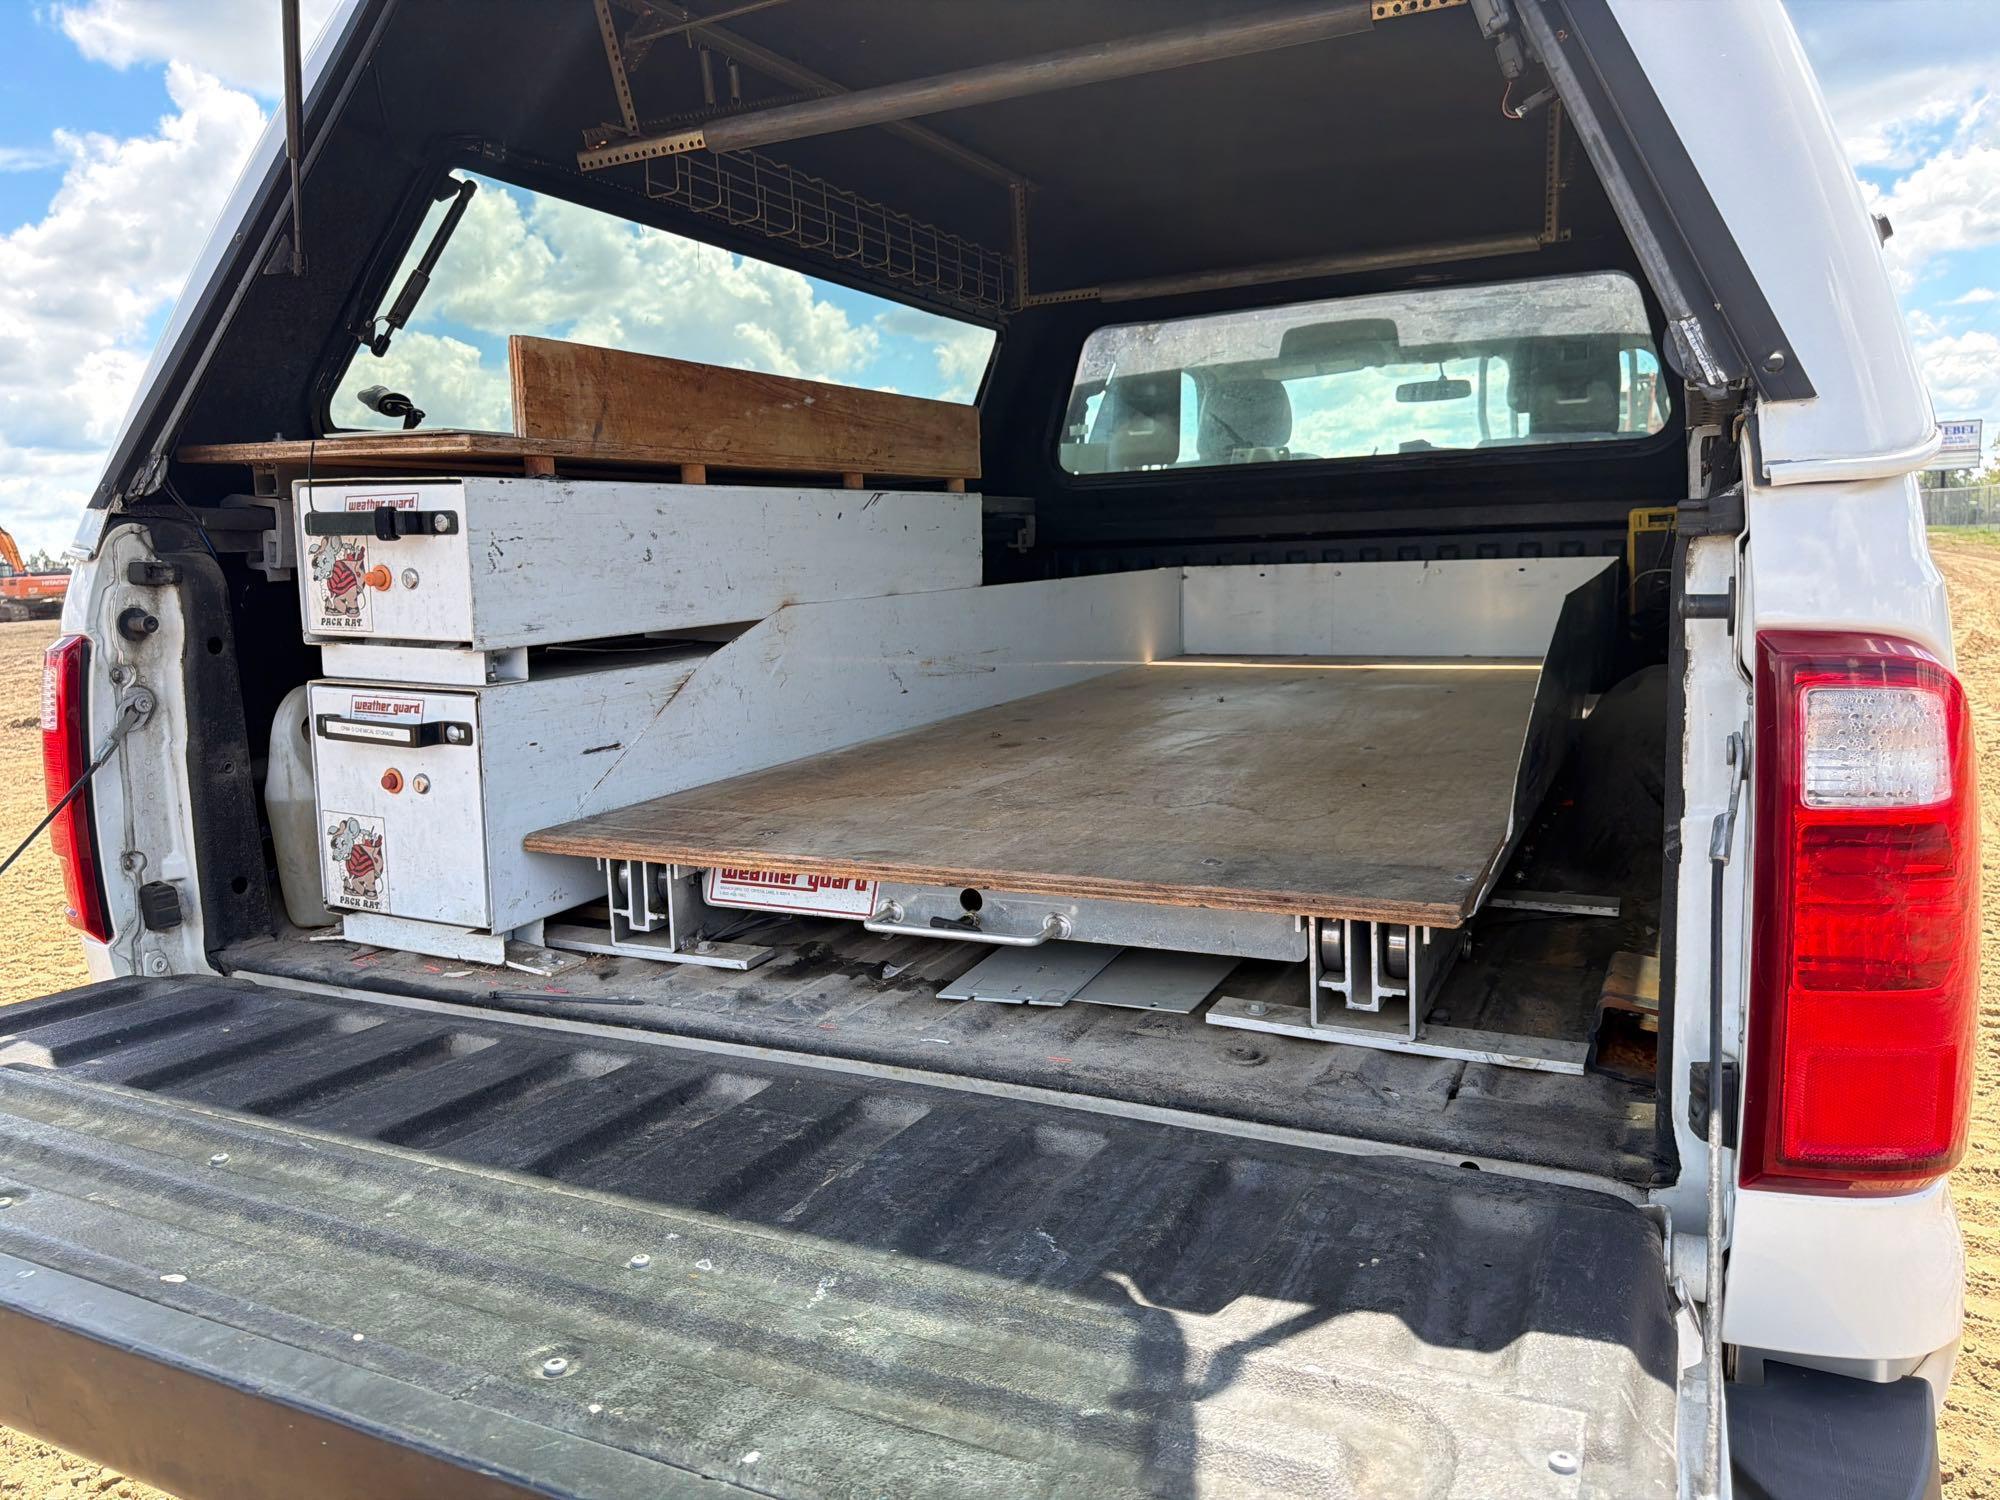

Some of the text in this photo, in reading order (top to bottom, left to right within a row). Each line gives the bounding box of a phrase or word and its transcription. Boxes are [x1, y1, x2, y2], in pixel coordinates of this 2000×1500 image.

[1938, 425, 1978, 435] EBEL
[321, 617, 362, 627] PACK RAT
[354, 700, 420, 715] weather guard
[340, 896, 380, 910] PACK RAT
